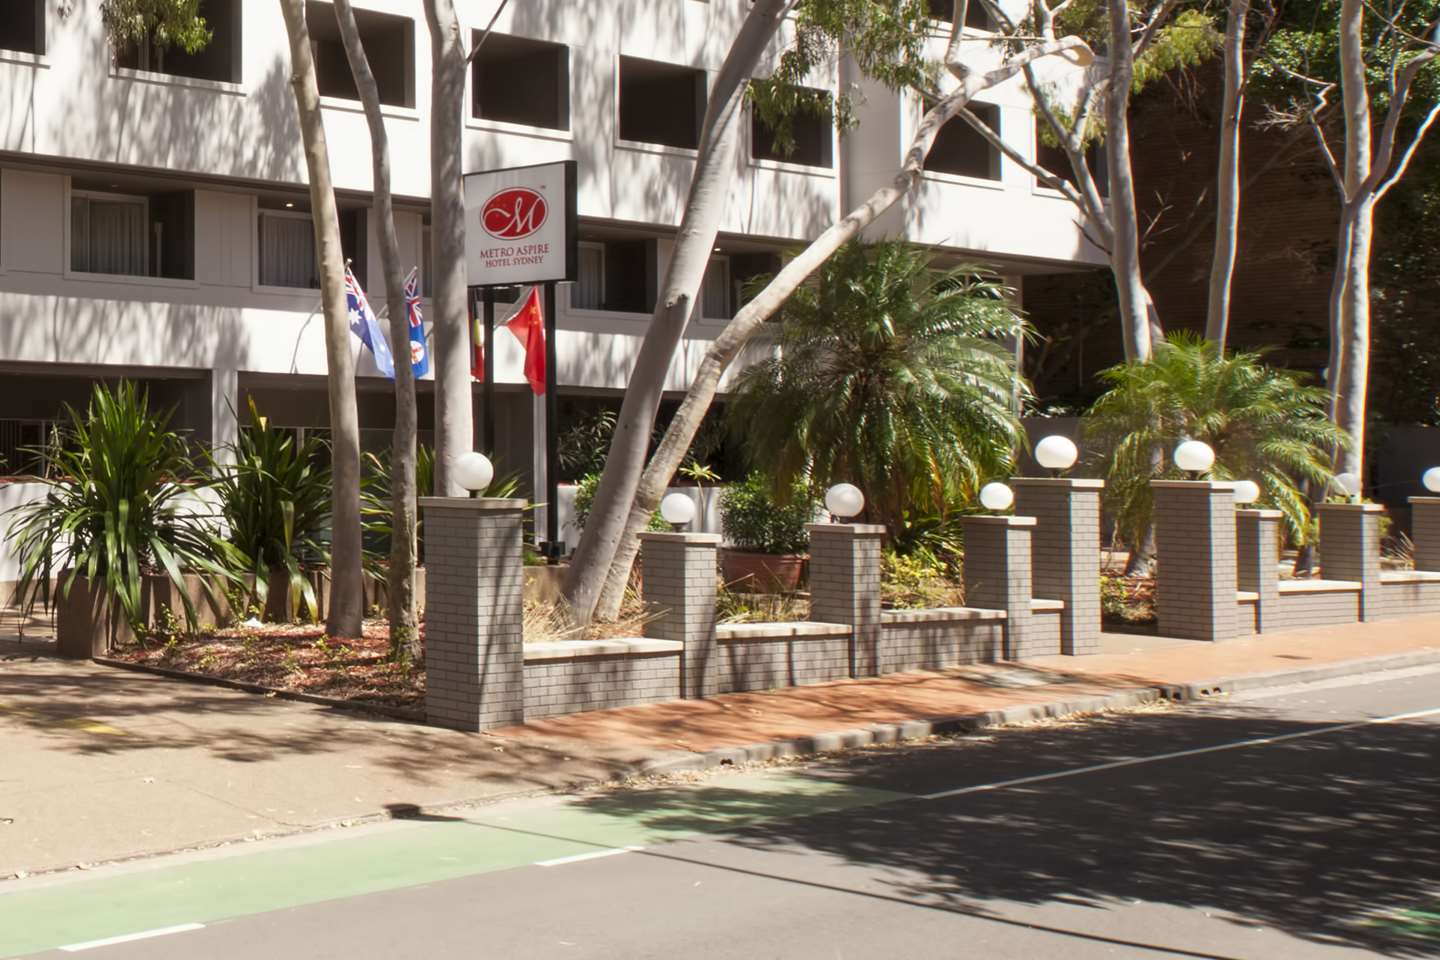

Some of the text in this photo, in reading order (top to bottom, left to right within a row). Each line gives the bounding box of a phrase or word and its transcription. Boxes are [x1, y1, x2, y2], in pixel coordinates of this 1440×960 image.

[480, 243, 550, 259] METRO ASPIRE
[486, 255, 544, 268] HOTEL SYDNEY
